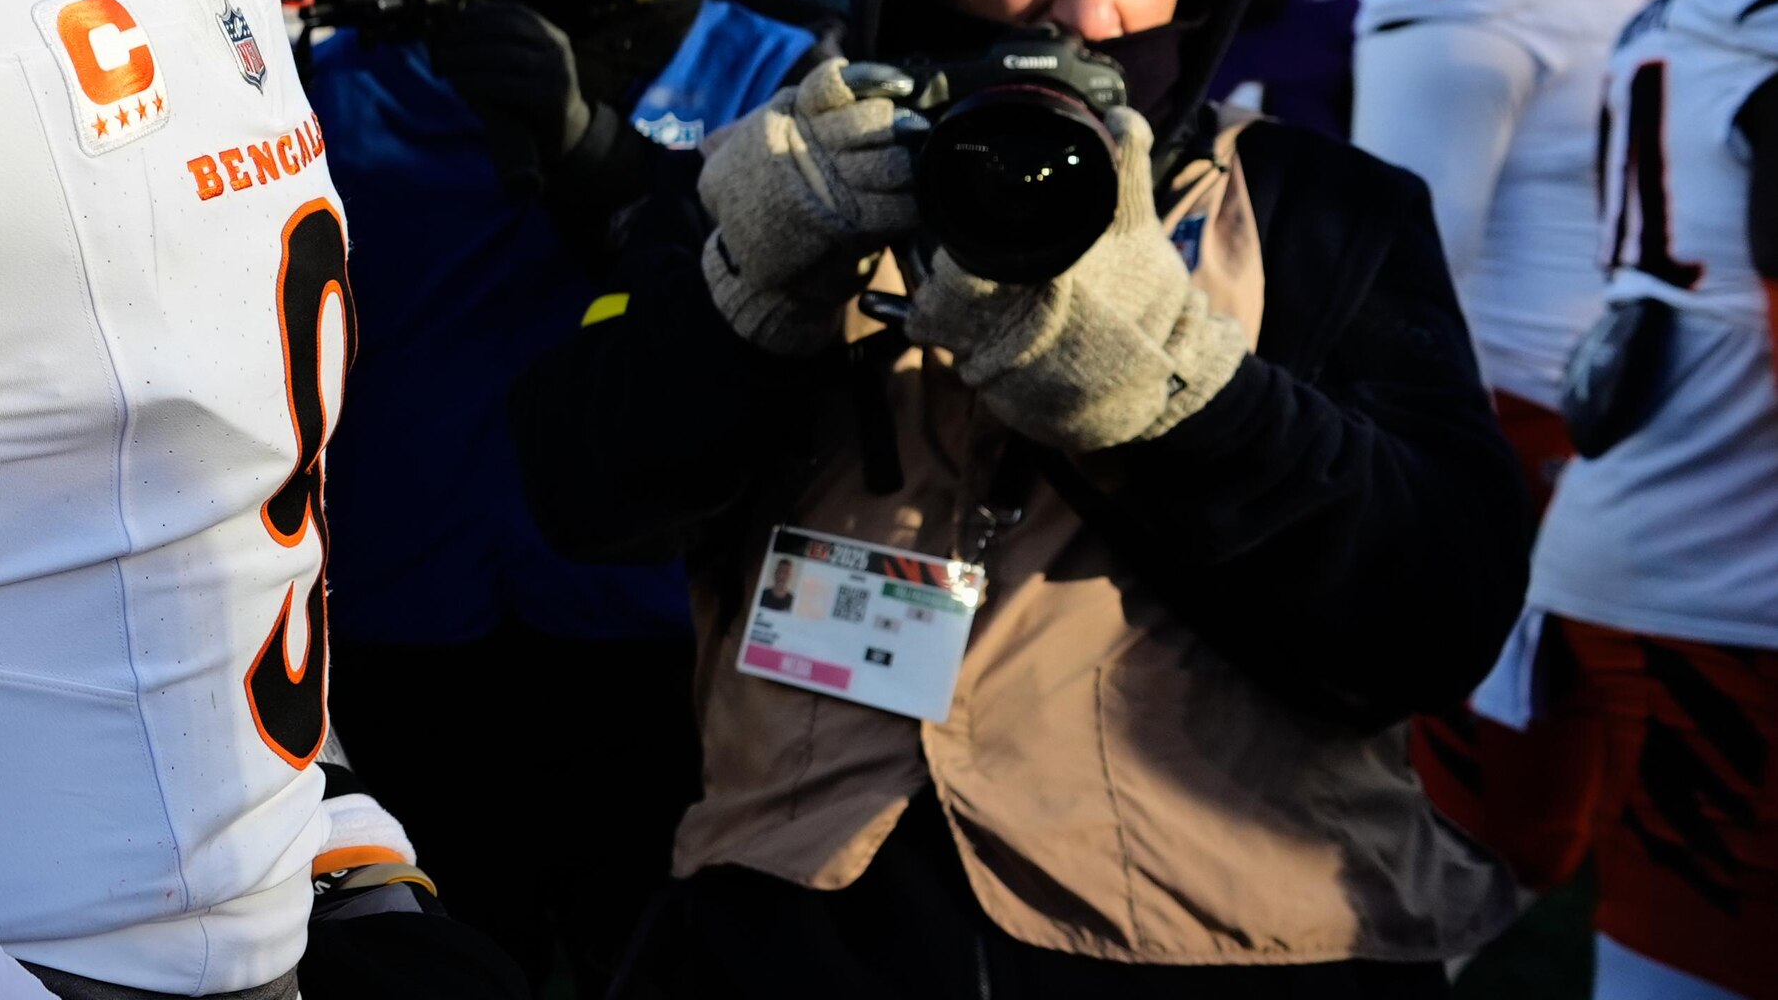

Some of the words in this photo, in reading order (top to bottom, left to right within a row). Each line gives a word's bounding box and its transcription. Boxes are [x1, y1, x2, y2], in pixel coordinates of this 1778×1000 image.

[237, 41, 265, 74] NFL
[1003, 54, 1058, 70] Canon
[244, 196, 358, 771] 9
